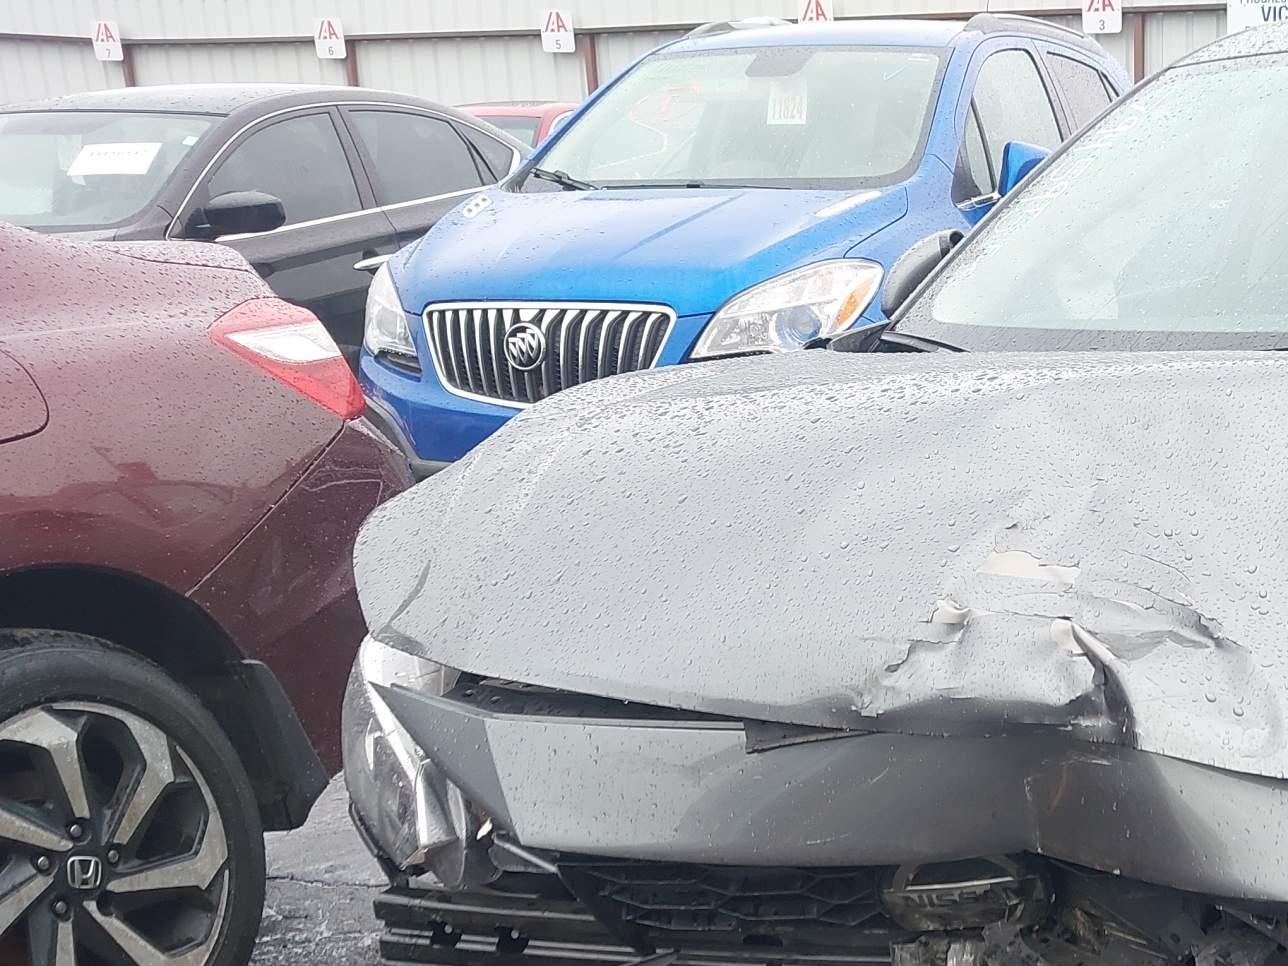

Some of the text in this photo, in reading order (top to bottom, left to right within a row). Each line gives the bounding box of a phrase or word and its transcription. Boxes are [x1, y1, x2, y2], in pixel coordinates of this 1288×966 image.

[1261, 5, 1288, 21] VIC
[1099, 19, 1105, 31] 3
[555, 39, 562, 50] 5
[105, 48, 111, 58] 7
[328, 46, 335, 57] 6
